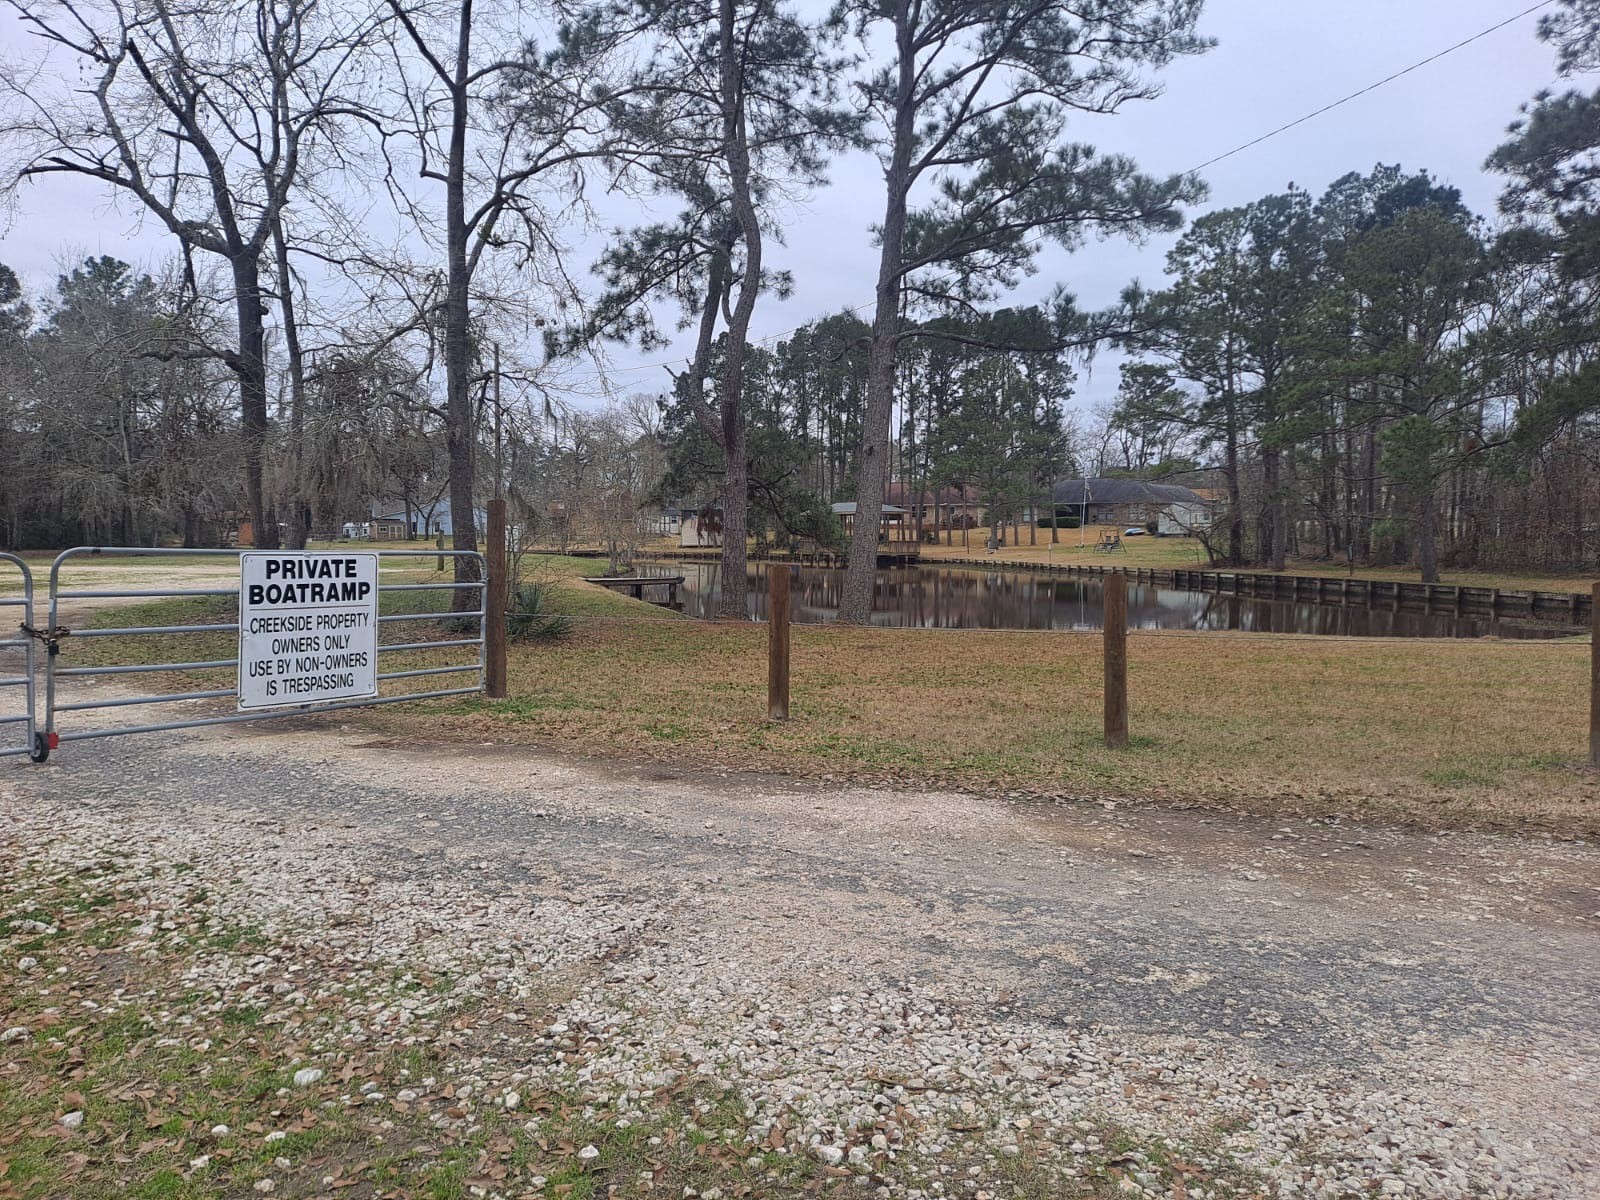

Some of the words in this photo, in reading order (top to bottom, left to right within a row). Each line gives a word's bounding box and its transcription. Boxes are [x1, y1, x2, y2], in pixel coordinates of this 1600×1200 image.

[266, 559, 357, 580] PRIVATE
[248, 582, 371, 605] BOATRAMP
[250, 615, 313, 634] CREEKSIDE
[316, 612, 369, 630] PROPERTY
[271, 636, 321, 655] OWNERS
[324, 634, 351, 651] ONLY
[249, 659, 273, 678] USE
[277, 658, 292, 675] BY
[295, 651, 368, 673] NON-OWNERS
[266, 680, 278, 697] IS
[282, 673, 354, 694] TRESPASSING
